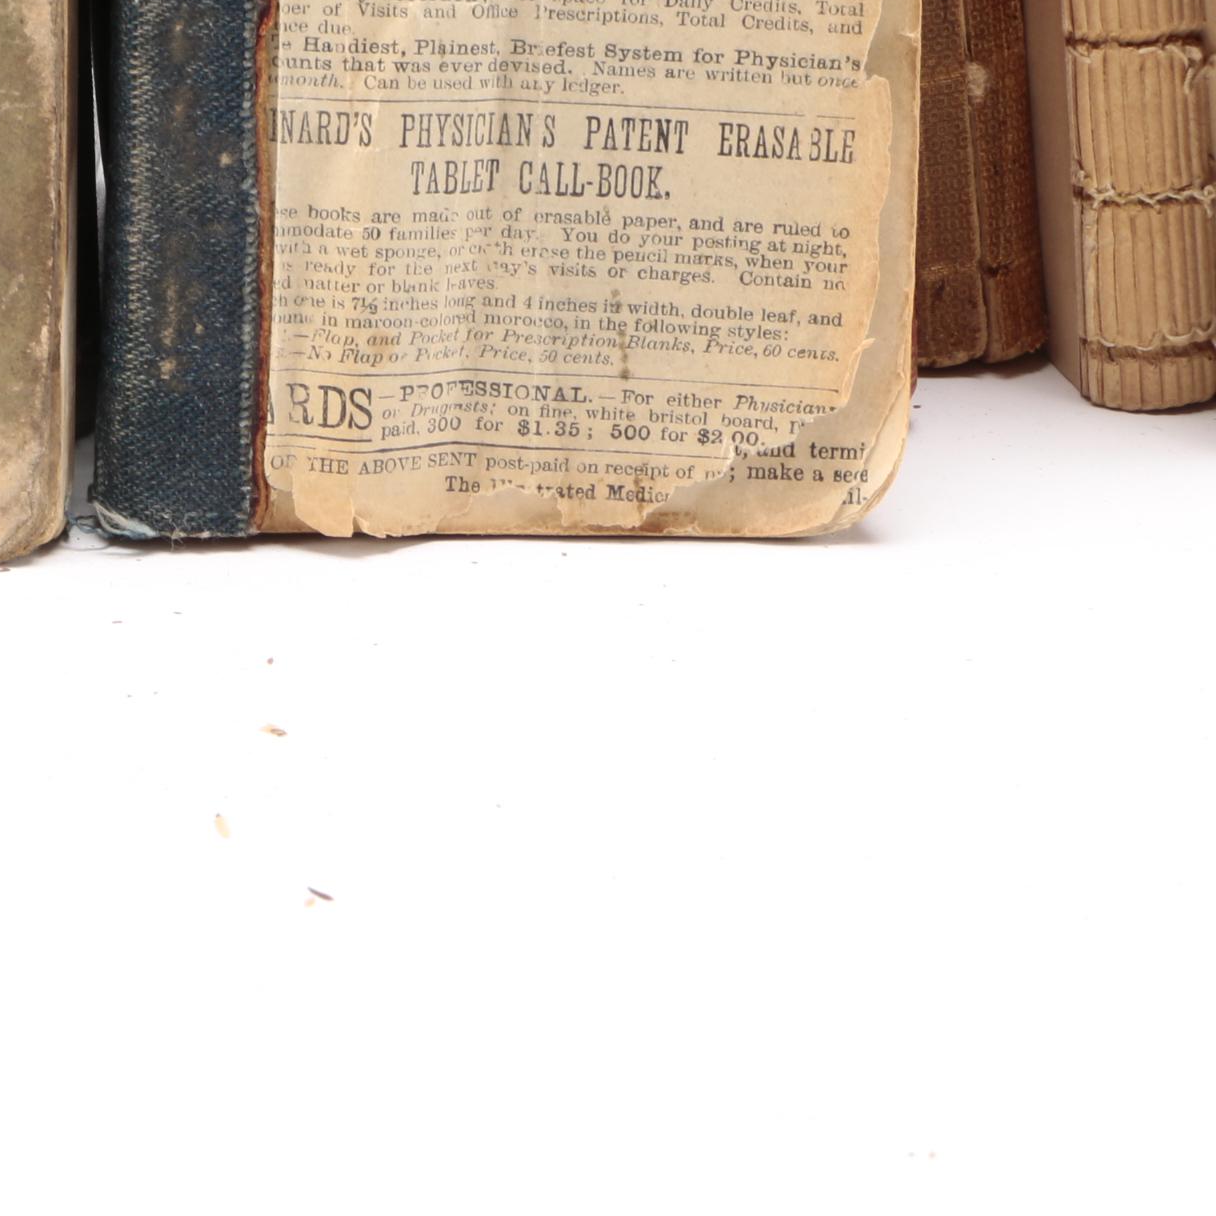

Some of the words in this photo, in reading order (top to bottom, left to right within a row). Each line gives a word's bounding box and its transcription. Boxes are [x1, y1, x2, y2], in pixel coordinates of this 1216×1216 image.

[358, 2, 409, 19] Visits
[676, 11, 725, 28] Total
[604, 42, 683, 63] System
[693, 48, 725, 64] for
[734, 49, 861, 71] Physician's
[342, 56, 385, 73] that
[391, 59, 431, 73] was
[439, 60, 482, 74] ever
[488, 59, 572, 75] devised.
[592, 61, 656, 79] Names
[665, 67, 695, 81] are
[705, 67, 772, 84] written
[584, 115, 689, 154] PATENT
[717, 121, 856, 165] ERASABLE
[411, 159, 499, 195] TABLET
[308, 205, 360, 222] books
[371, 212, 401, 224] are
[503, 208, 522, 222] of
[623, 214, 682, 232] paper,
[689, 216, 724, 232] and
[733, 219, 764, 235] are
[362, 227, 381, 241] 50
[561, 227, 598, 243] You
[608, 229, 630, 244] do
[640, 234, 683, 249] your
[793, 242, 847, 259] night,
[550, 263, 597, 277] visits
[638, 265, 716, 284] charges.
[739, 271, 812, 290] Contain
[745, 256, 794, 270] when
[803, 261, 848, 275] your
[482, 295, 516, 309] and
[538, 297, 597, 313] inches
[627, 302, 685, 318] width,
[690, 305, 754, 322] double
[808, 311, 843, 327] and
[598, 319, 628, 332] the
[634, 320, 722, 339] following
[727, 325, 789, 342] styles:
[479, 344, 532, 364] Price,
[563, 352, 614, 366] cents.
[626, 335, 695, 354] Blanks,
[702, 338, 758, 359] Price,
[763, 344, 782, 358] 60
[620, 389, 654, 405] For
[666, 394, 722, 409] either
[507, 406, 529, 417] on
[585, 407, 636, 422] white
[648, 411, 708, 426] bristol
[427, 417, 461, 433] 300
[475, 418, 504, 432] for
[610, 424, 651, 441] 500
[660, 428, 688, 442] for
[358, 455, 422, 475] ABOVE
[427, 452, 477, 468] SENT
[484, 453, 569, 475] post-paid
[675, 464, 695, 479] of
[747, 463, 804, 480] make
[445, 475, 481, 493] The
